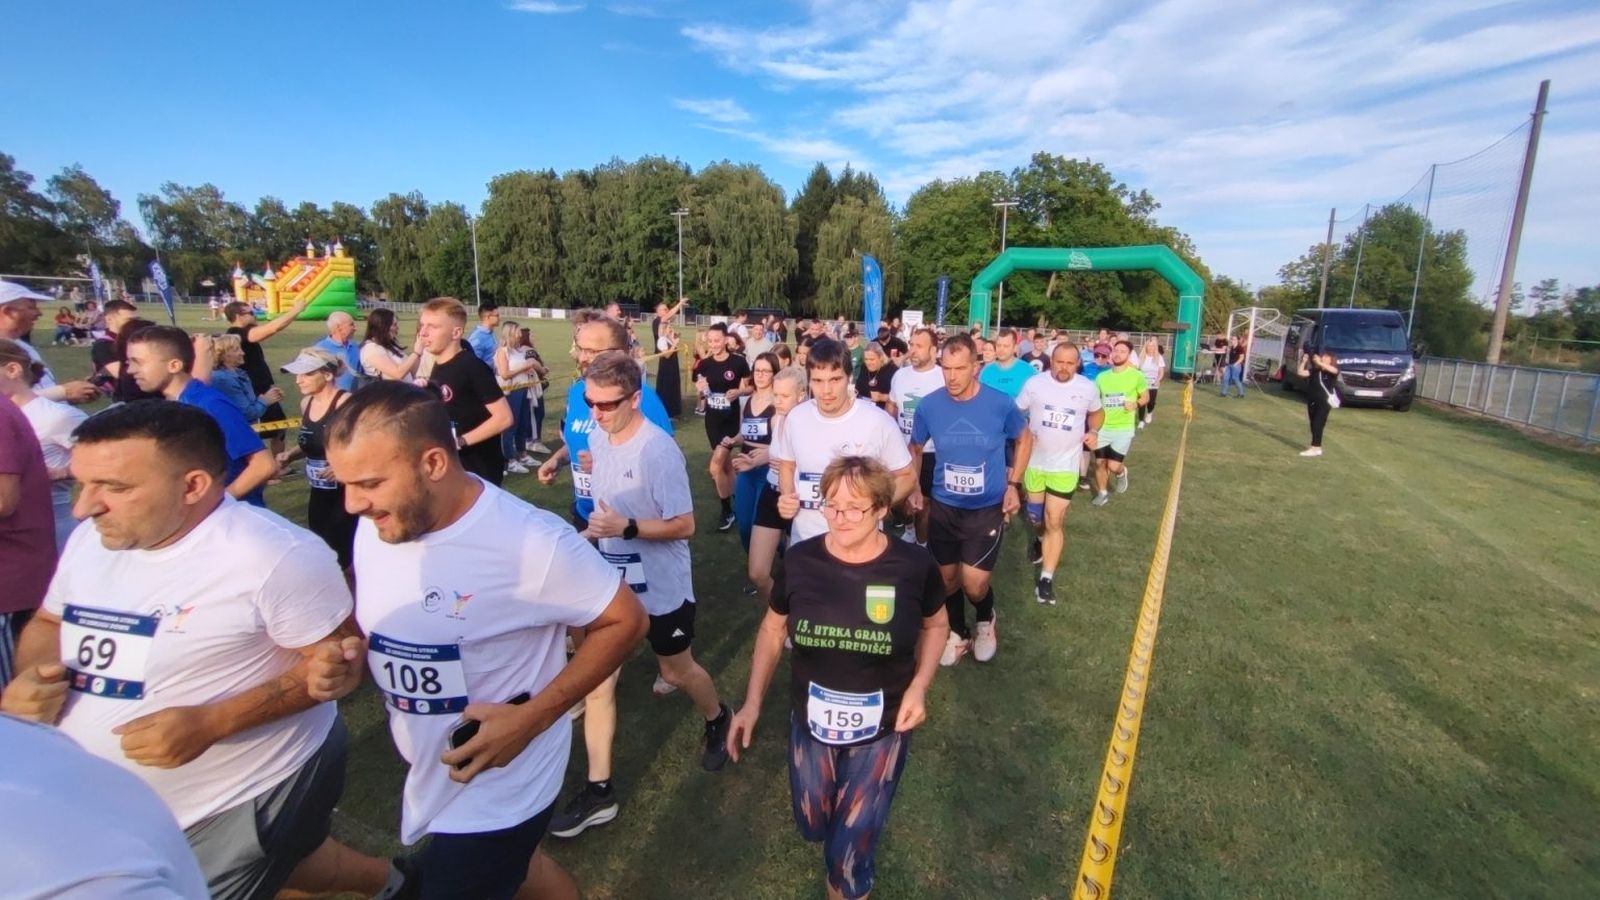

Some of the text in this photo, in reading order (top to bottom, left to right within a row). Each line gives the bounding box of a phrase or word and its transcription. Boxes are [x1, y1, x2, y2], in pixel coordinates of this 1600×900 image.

[1049, 412, 1069, 424] 107
[747, 425, 759, 434] 23
[954, 475, 975, 486] 180
[814, 625, 851, 638] UTRKA
[854, 629, 892, 643] GRADA
[78, 635, 117, 670] 69
[838, 639, 892, 655] SREDIŠĆE
[383, 661, 442, 695] 108
[823, 709, 864, 728] 159
